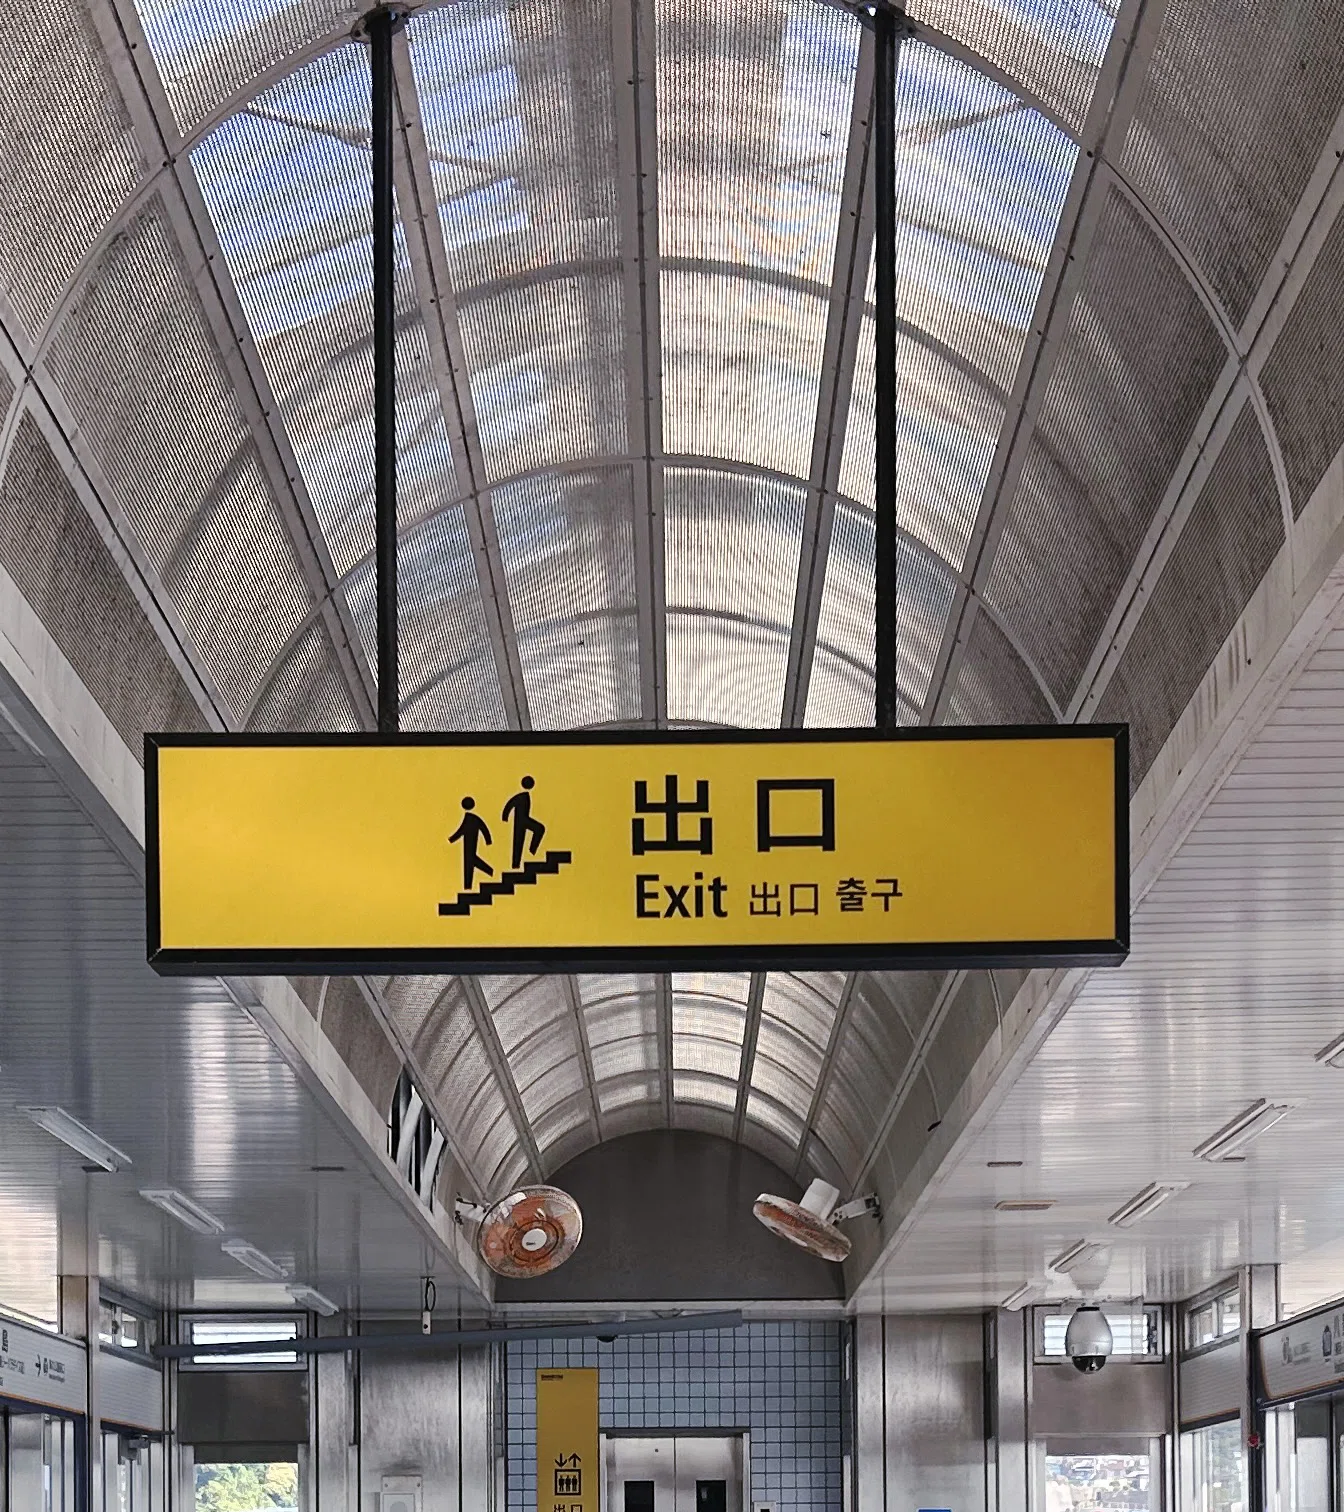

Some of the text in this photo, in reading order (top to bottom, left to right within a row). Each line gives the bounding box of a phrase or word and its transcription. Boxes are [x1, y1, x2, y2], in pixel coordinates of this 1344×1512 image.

[631, 774, 835, 856] 出口
[636, 872, 903, 918] Exit 出口 출구
